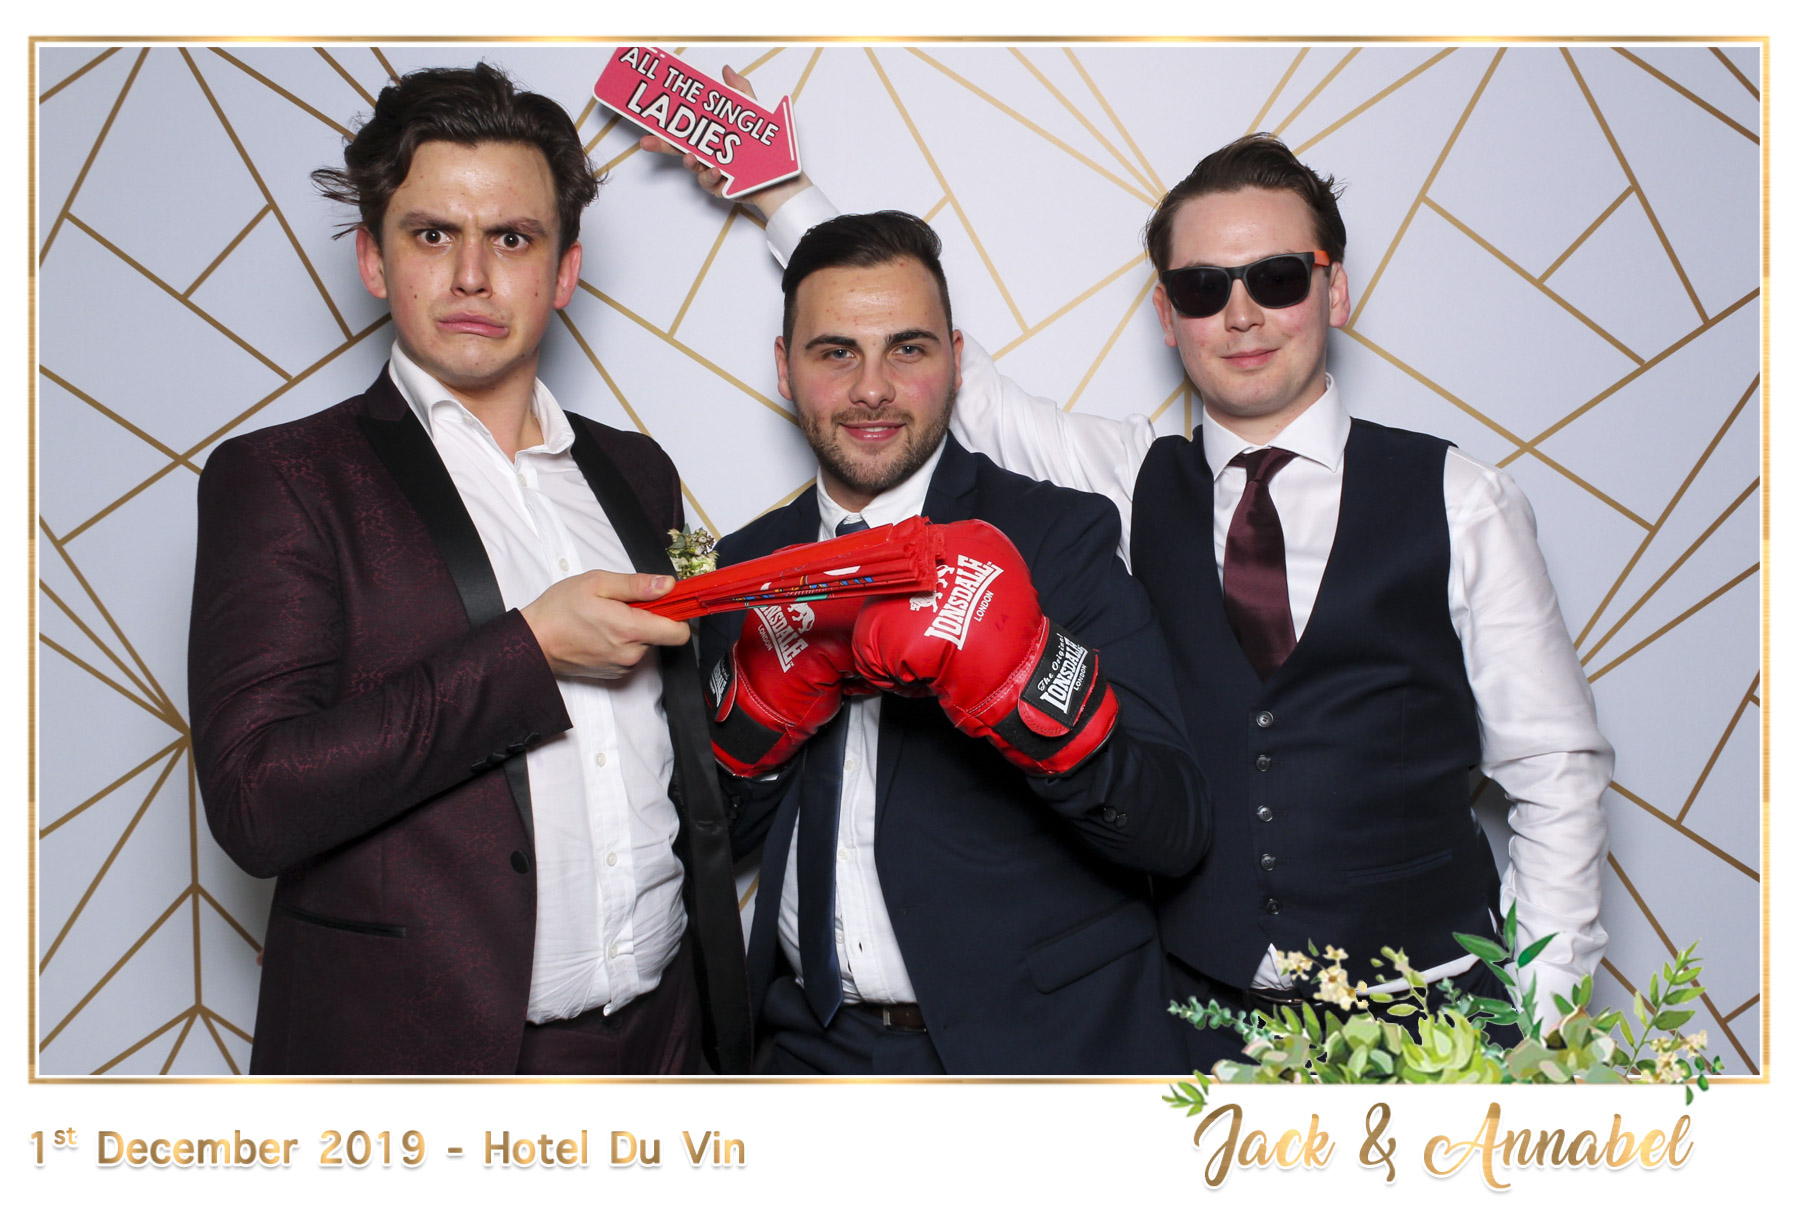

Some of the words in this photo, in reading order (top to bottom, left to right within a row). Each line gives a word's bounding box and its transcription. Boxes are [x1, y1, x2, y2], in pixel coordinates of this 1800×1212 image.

[619, 47, 660, 80] ALL
[663, 65, 704, 104] THE
[702, 91, 779, 147] SINGLE
[626, 79, 742, 165] LADIES
[924, 554, 1003, 651] LONSDALE
[974, 590, 995, 622] LONDON
[1037, 673, 1054, 691] The
[1073, 663, 1087, 691] LONDON
